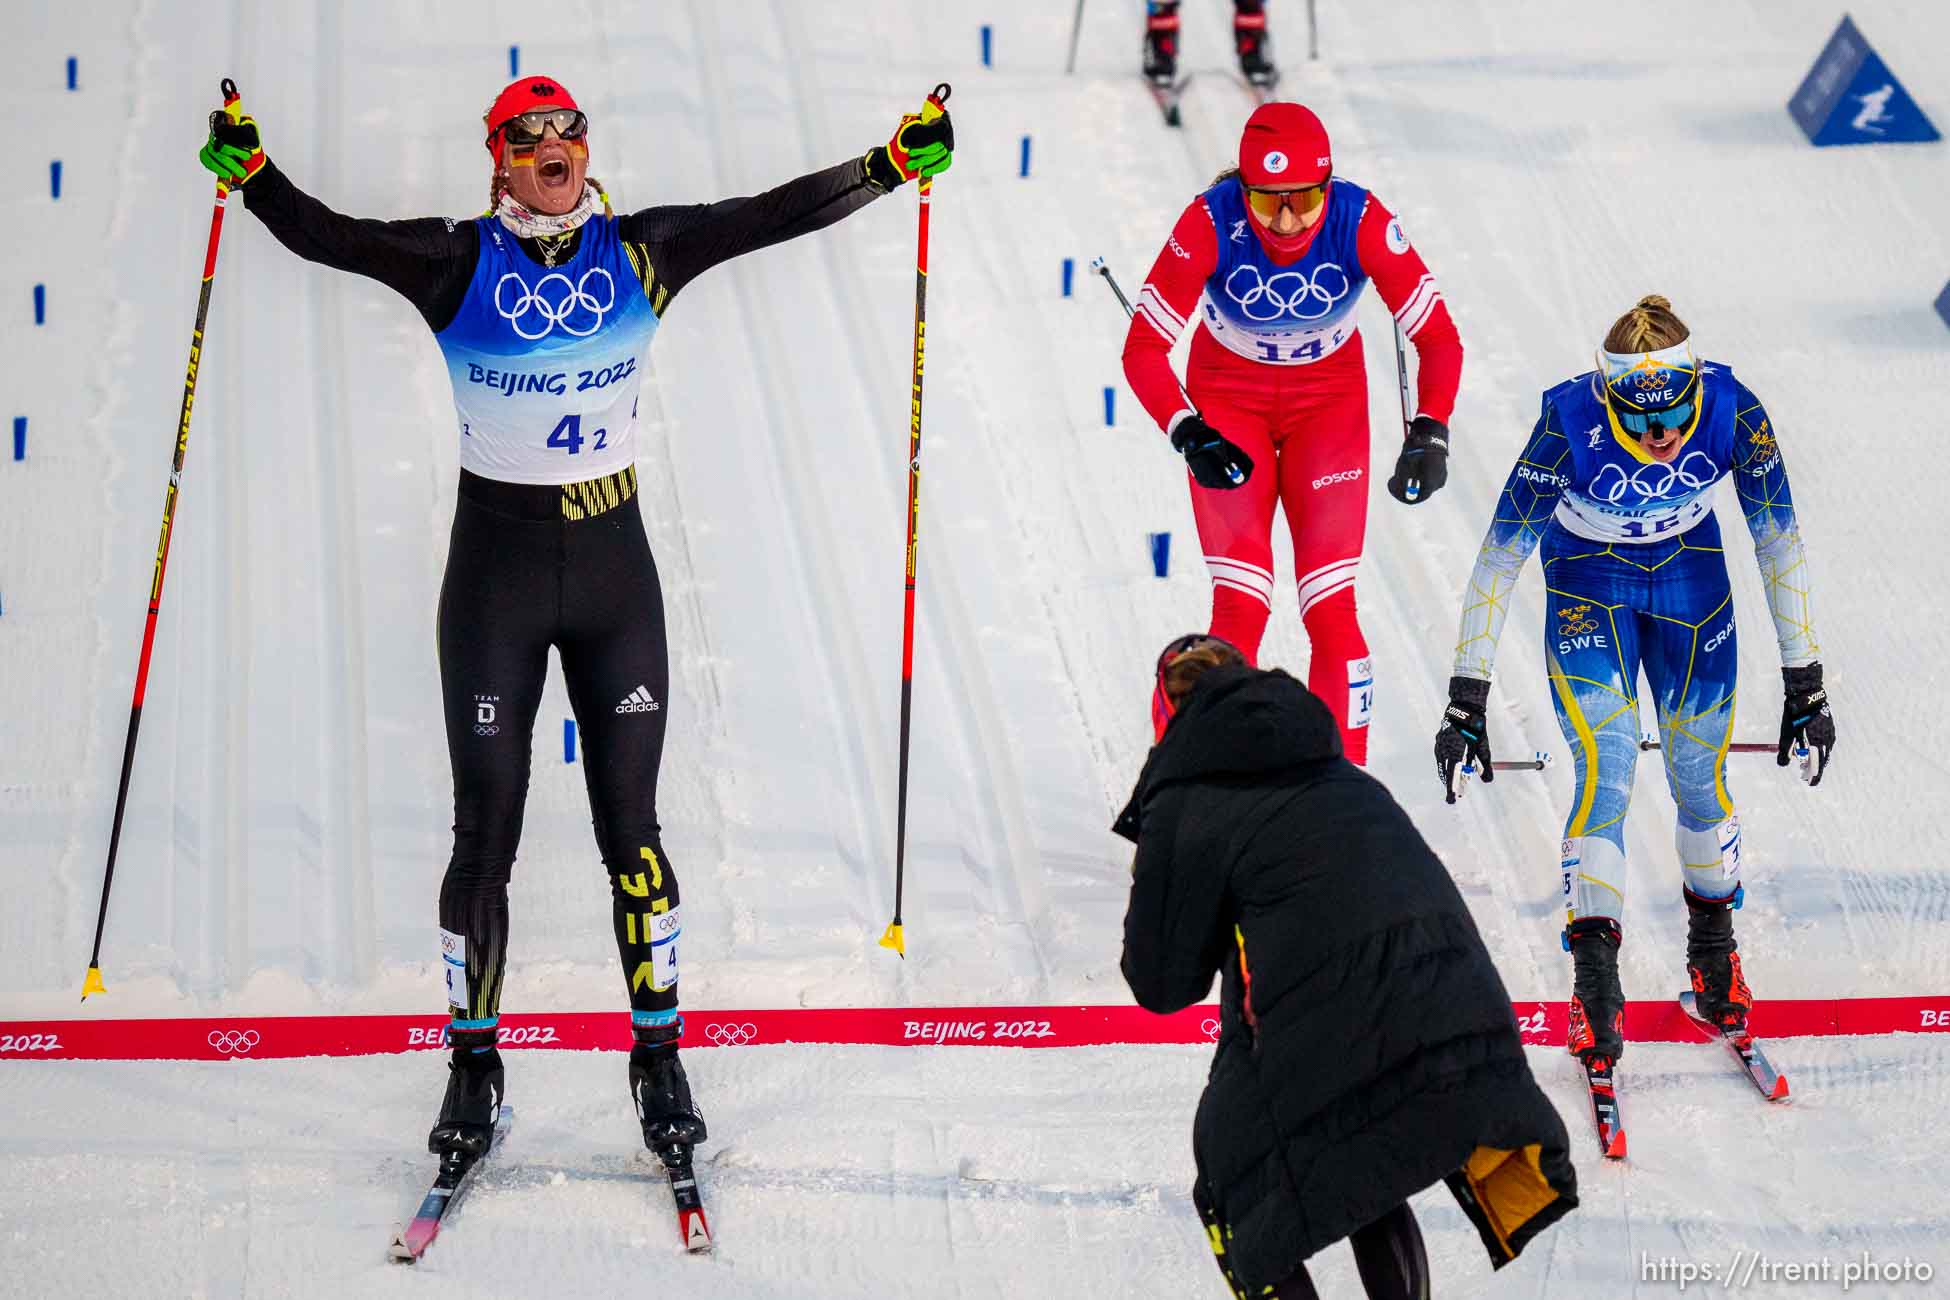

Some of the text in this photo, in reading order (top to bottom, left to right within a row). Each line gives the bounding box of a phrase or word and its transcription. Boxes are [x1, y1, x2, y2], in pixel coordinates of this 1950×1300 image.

[467, 357, 637, 397] BEIJING 2022
[1635, 388, 1675, 404] SWE
[546, 414, 608, 456] 4 2
[1752, 449, 1780, 477] SWE
[1311, 470, 1359, 490] BOSCO
[1517, 465, 1560, 486] CRAFT
[1558, 635, 1609, 655] SWE
[615, 700, 660, 715] adidas
[668, 945, 678, 968] 4
[904, 1020, 1057, 1044] BEIJING 2022
[1518, 1010, 1552, 1034] 22
[0, 1034, 65, 1052] 2022
[496, 1026, 561, 1045] 2022
